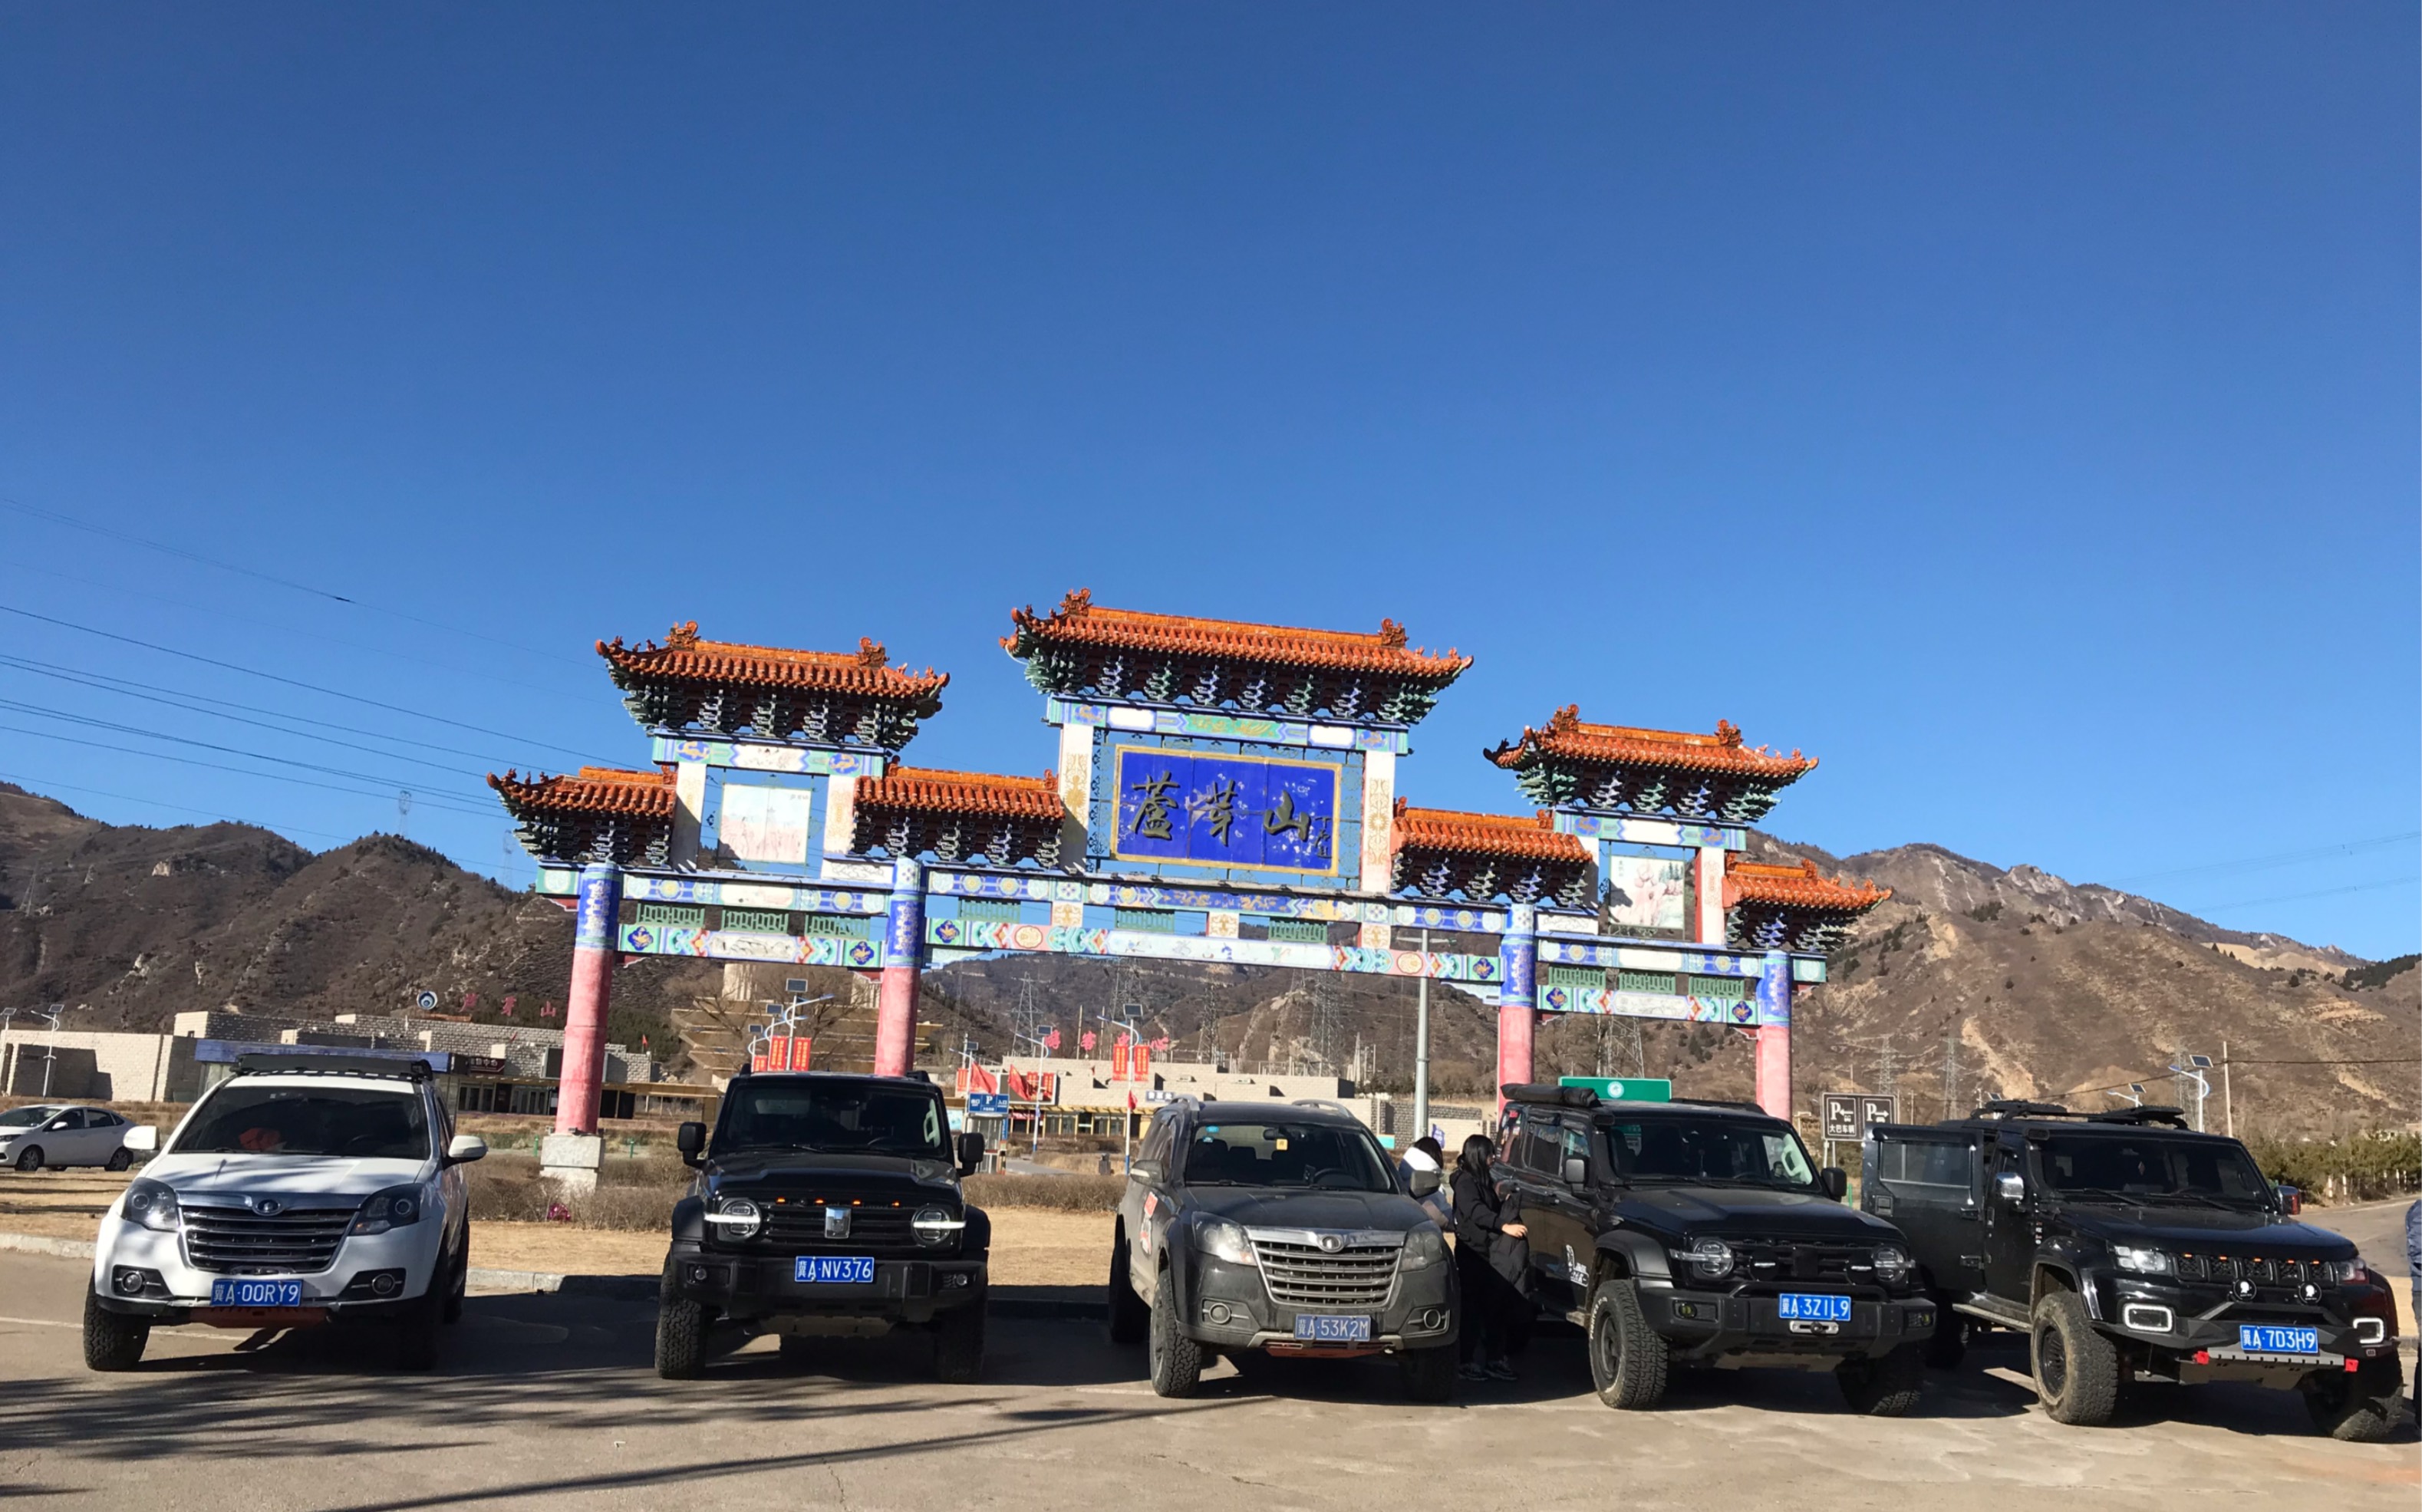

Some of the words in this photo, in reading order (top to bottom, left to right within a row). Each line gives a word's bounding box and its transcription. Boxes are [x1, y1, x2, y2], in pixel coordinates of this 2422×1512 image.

[985, 1095, 993, 1105] P
[1830, 1102, 1840, 1120] P
[1865, 1102, 1877, 1122] P
